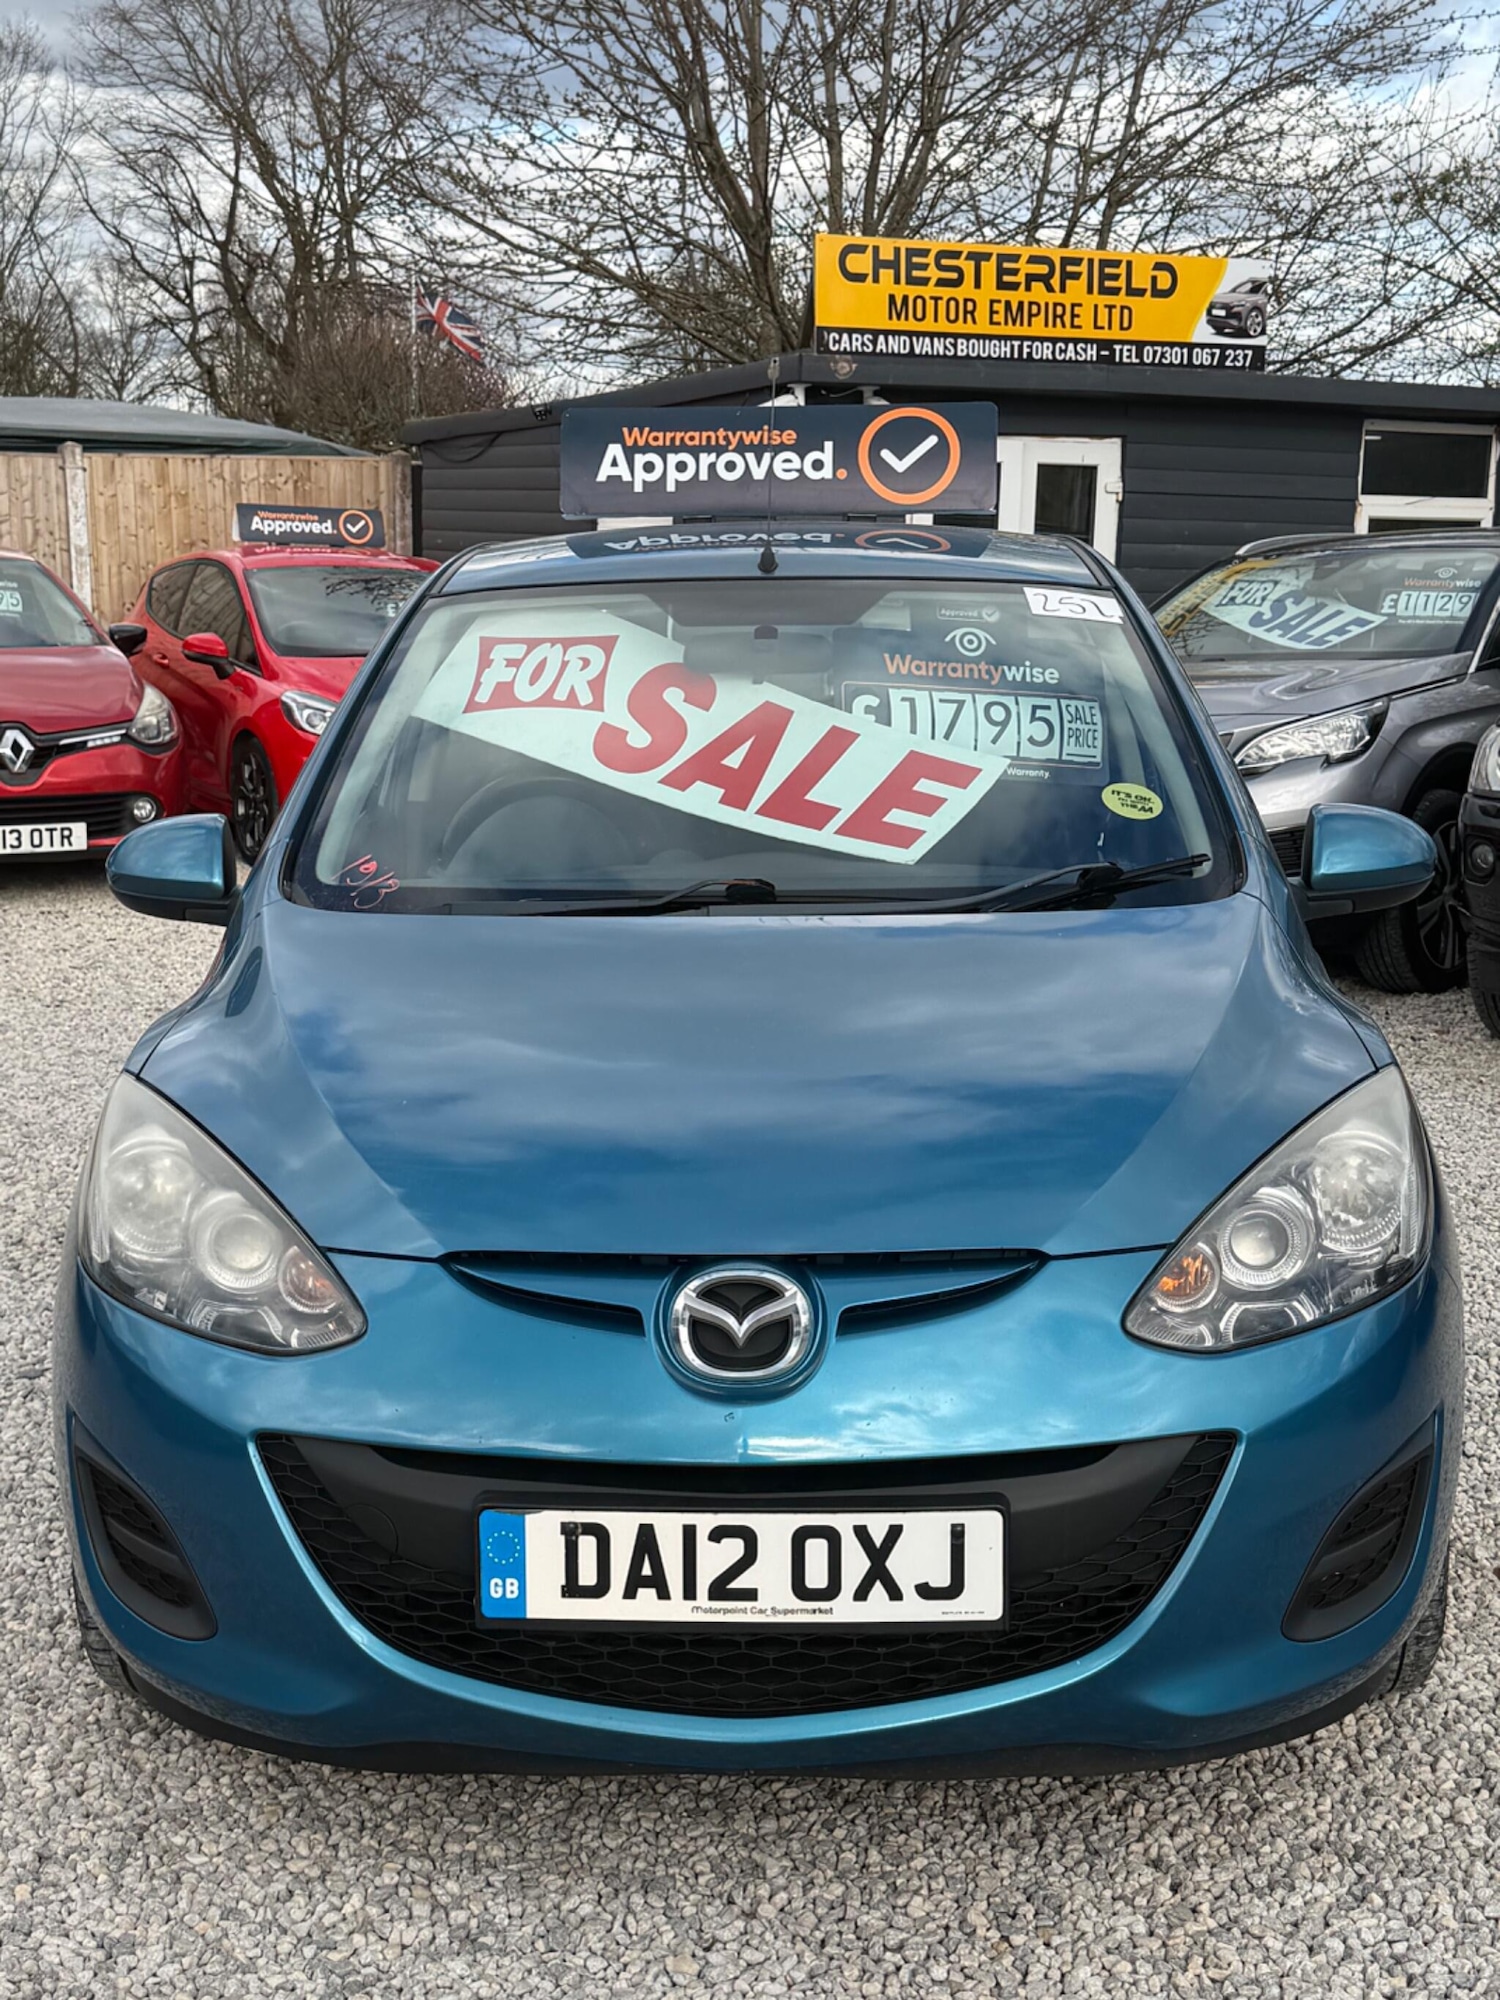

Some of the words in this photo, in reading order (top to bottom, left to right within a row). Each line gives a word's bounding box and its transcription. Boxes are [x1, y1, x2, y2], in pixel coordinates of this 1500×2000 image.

[838, 243, 1179, 299] CHESTERFIELD
[887, 293, 978, 326] MOTOR
[989, 299, 1083, 330] EMPIRE
[1093, 303, 1134, 332] LTD
[828, 332, 873, 353] CARS
[875, 334, 910, 355] AND
[912, 336, 957, 356] VANS
[957, 338, 1021, 359] BOUGHT
[1023, 340, 1053, 360] FOR
[1056, 342, 1097, 361] CASH
[1113, 344, 1140, 363] TEL
[1143, 346, 1188, 365] 07301
[1192, 347, 1220, 366] 067
[1225, 349, 1253, 368] 237
[622, 425, 798, 450] Warrantywise
[595, 440, 848, 493] Approved.
[250, 515, 338, 536] Approved.
[257, 510, 319, 522] Warrantywise
[1220, 580, 1276, 605] FOR
[1403, 578, 1482, 589] Warrantywise
[1248, 590, 1375, 648] SALE
[475, 642, 607, 706] FOR
[882, 653, 1061, 686] Warrantywise
[1065, 704, 1099, 727] SALE
[1066, 726, 1099, 750] PRICE
[592, 662, 984, 850] SALE
[30, 826, 73, 849] OTR
[560, 1521, 759, 1602] DA12
[790, 1522, 966, 1602] OXJ
[489, 1578, 519, 1600] GB
[691, 1605, 748, 1616] Motorpoint
[750, 1605, 768, 1615] Car
[770, 1605, 834, 1616] Supermarket
